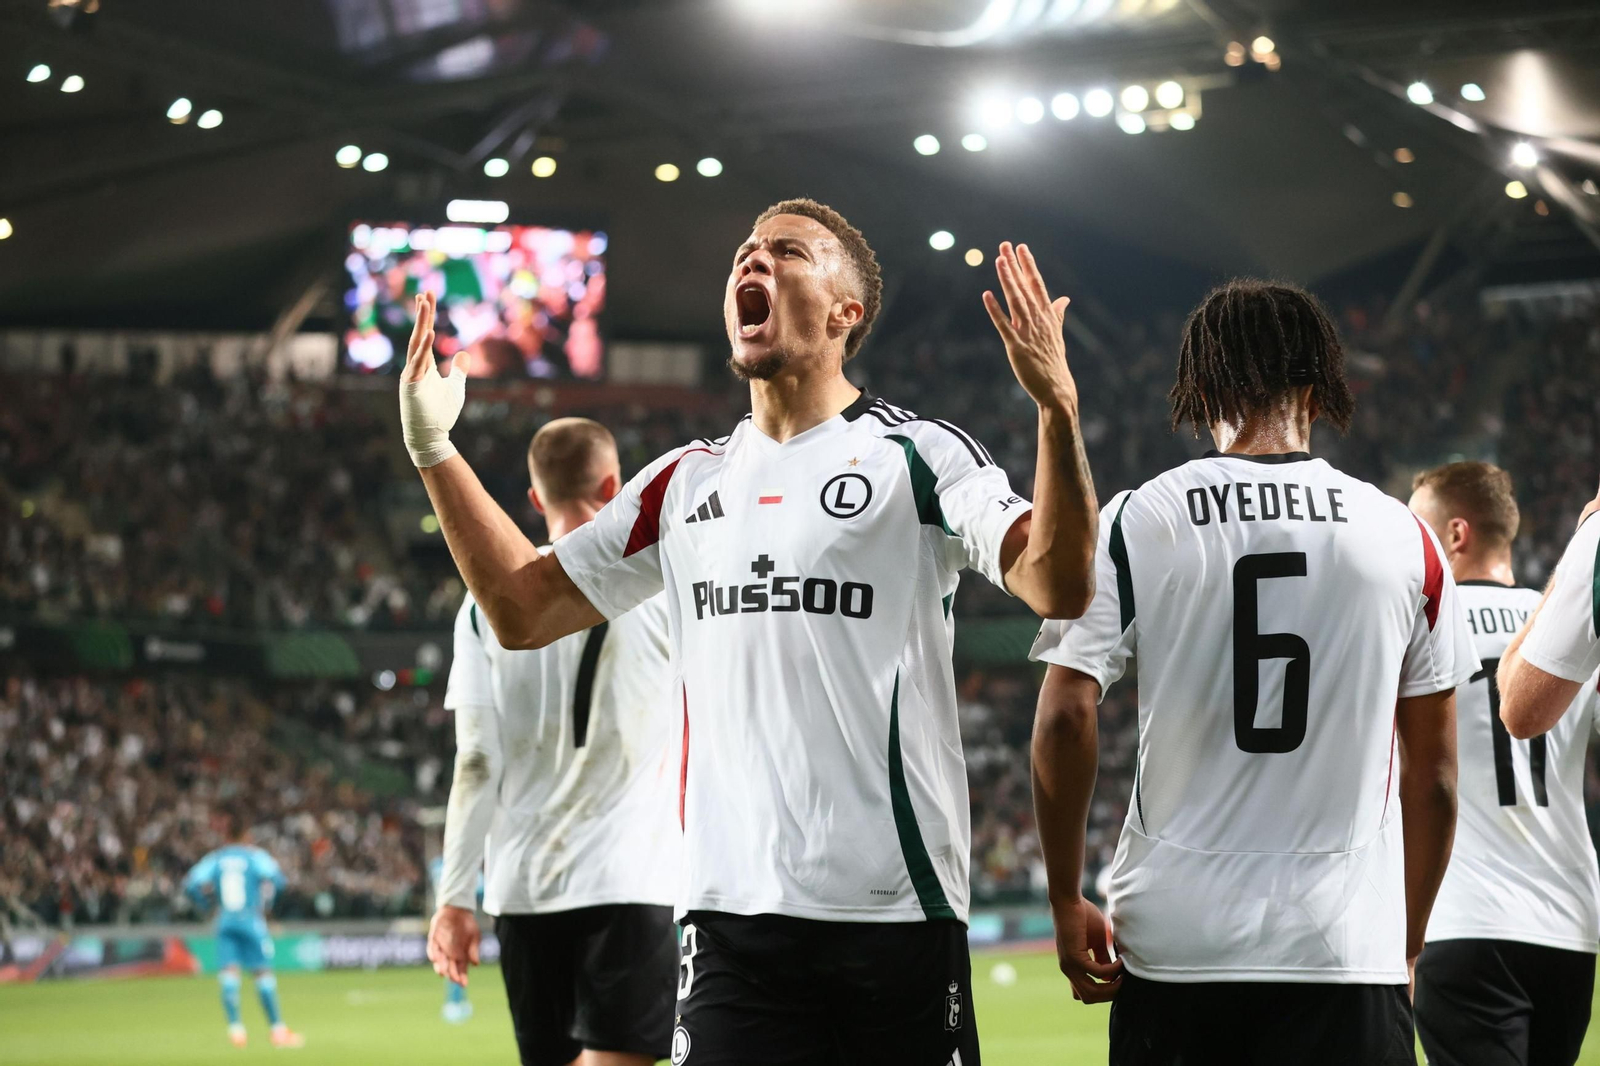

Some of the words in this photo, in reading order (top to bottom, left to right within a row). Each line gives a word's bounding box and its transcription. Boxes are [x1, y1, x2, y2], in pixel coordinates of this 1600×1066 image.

[834, 481, 856, 509] L
[1186, 482, 1348, 525] OYEDELE
[692, 576, 874, 620] Plus500
[1233, 552, 1310, 753] 6
